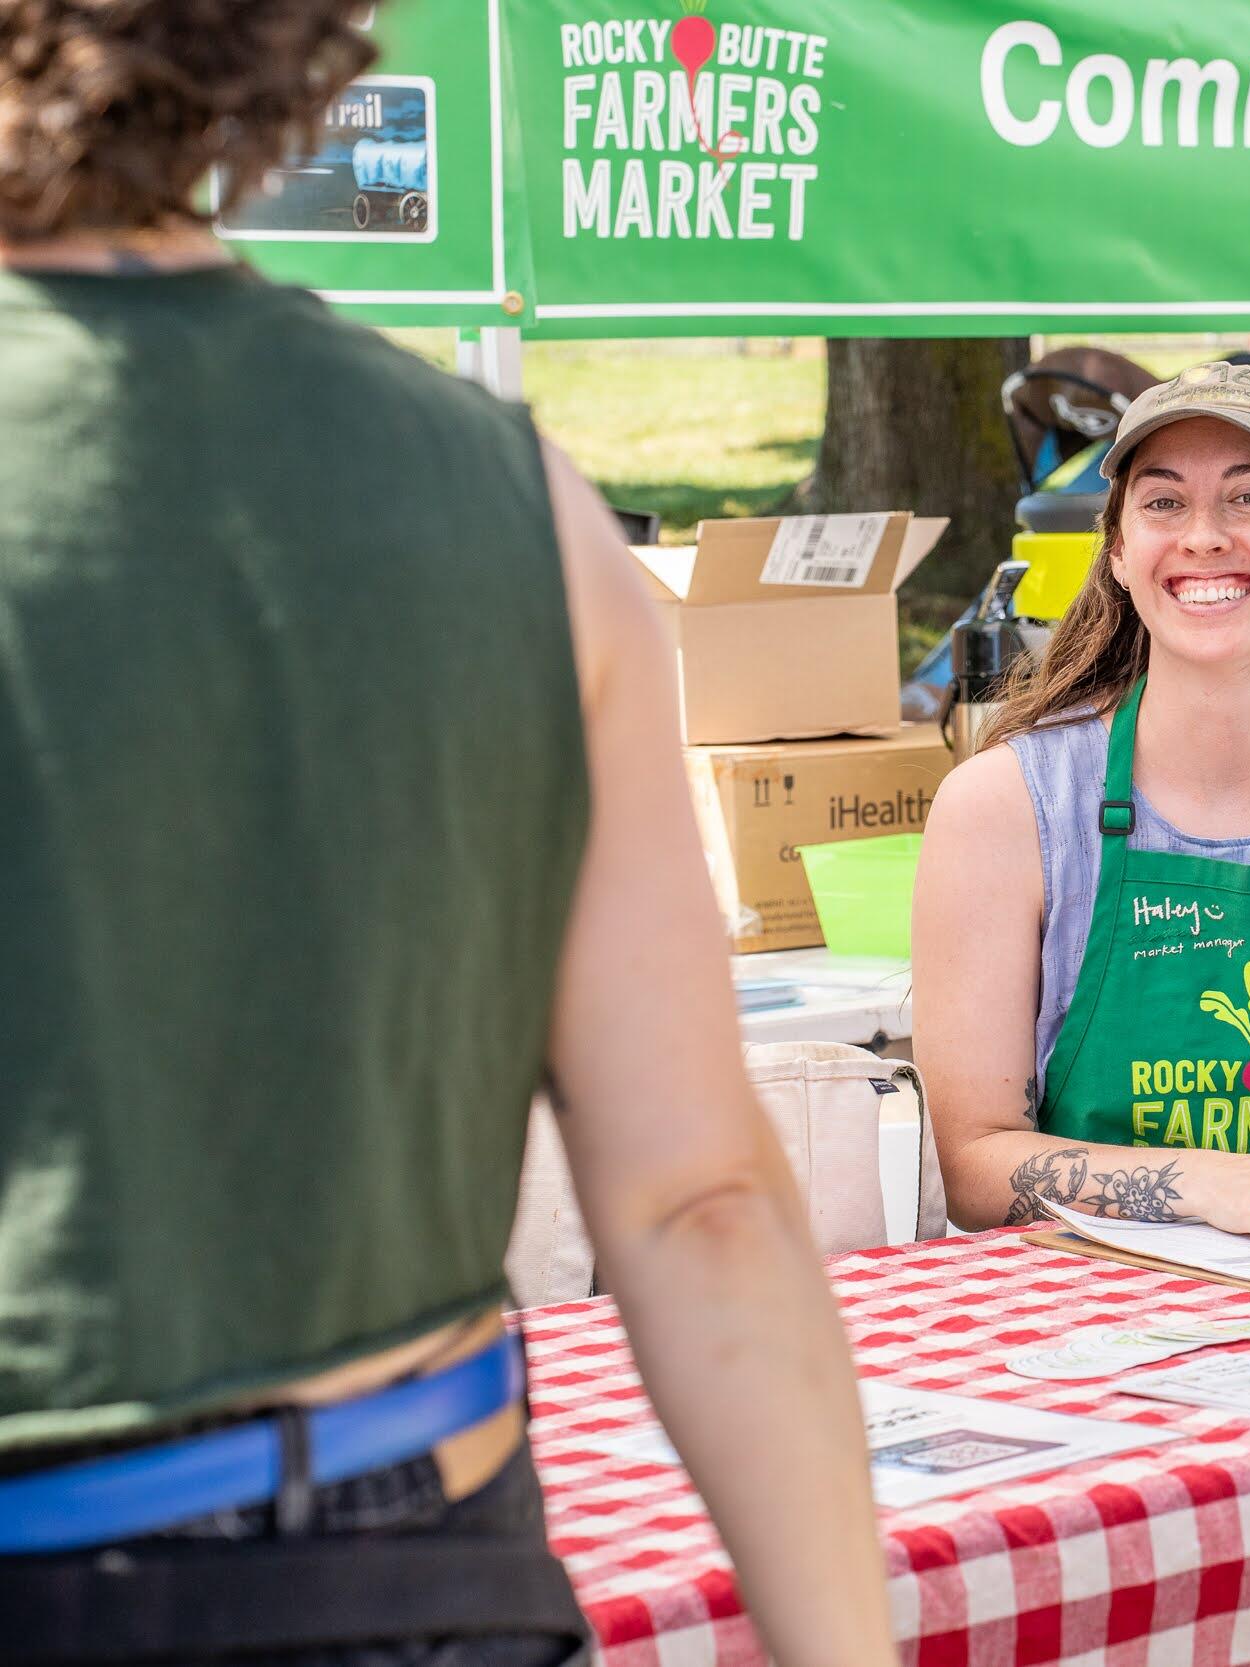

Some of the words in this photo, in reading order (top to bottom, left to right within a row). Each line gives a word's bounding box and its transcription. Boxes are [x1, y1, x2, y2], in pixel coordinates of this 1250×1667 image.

[560, 19, 672, 68] ROCKY
[717, 22, 828, 79] BUTTE
[563, 69, 822, 155] FARMERS
[562, 158, 819, 241] MARKET
[1133, 896, 1200, 935] Haley
[1134, 943, 1184, 960] market
[1131, 1060, 1242, 1095] ROCKY
